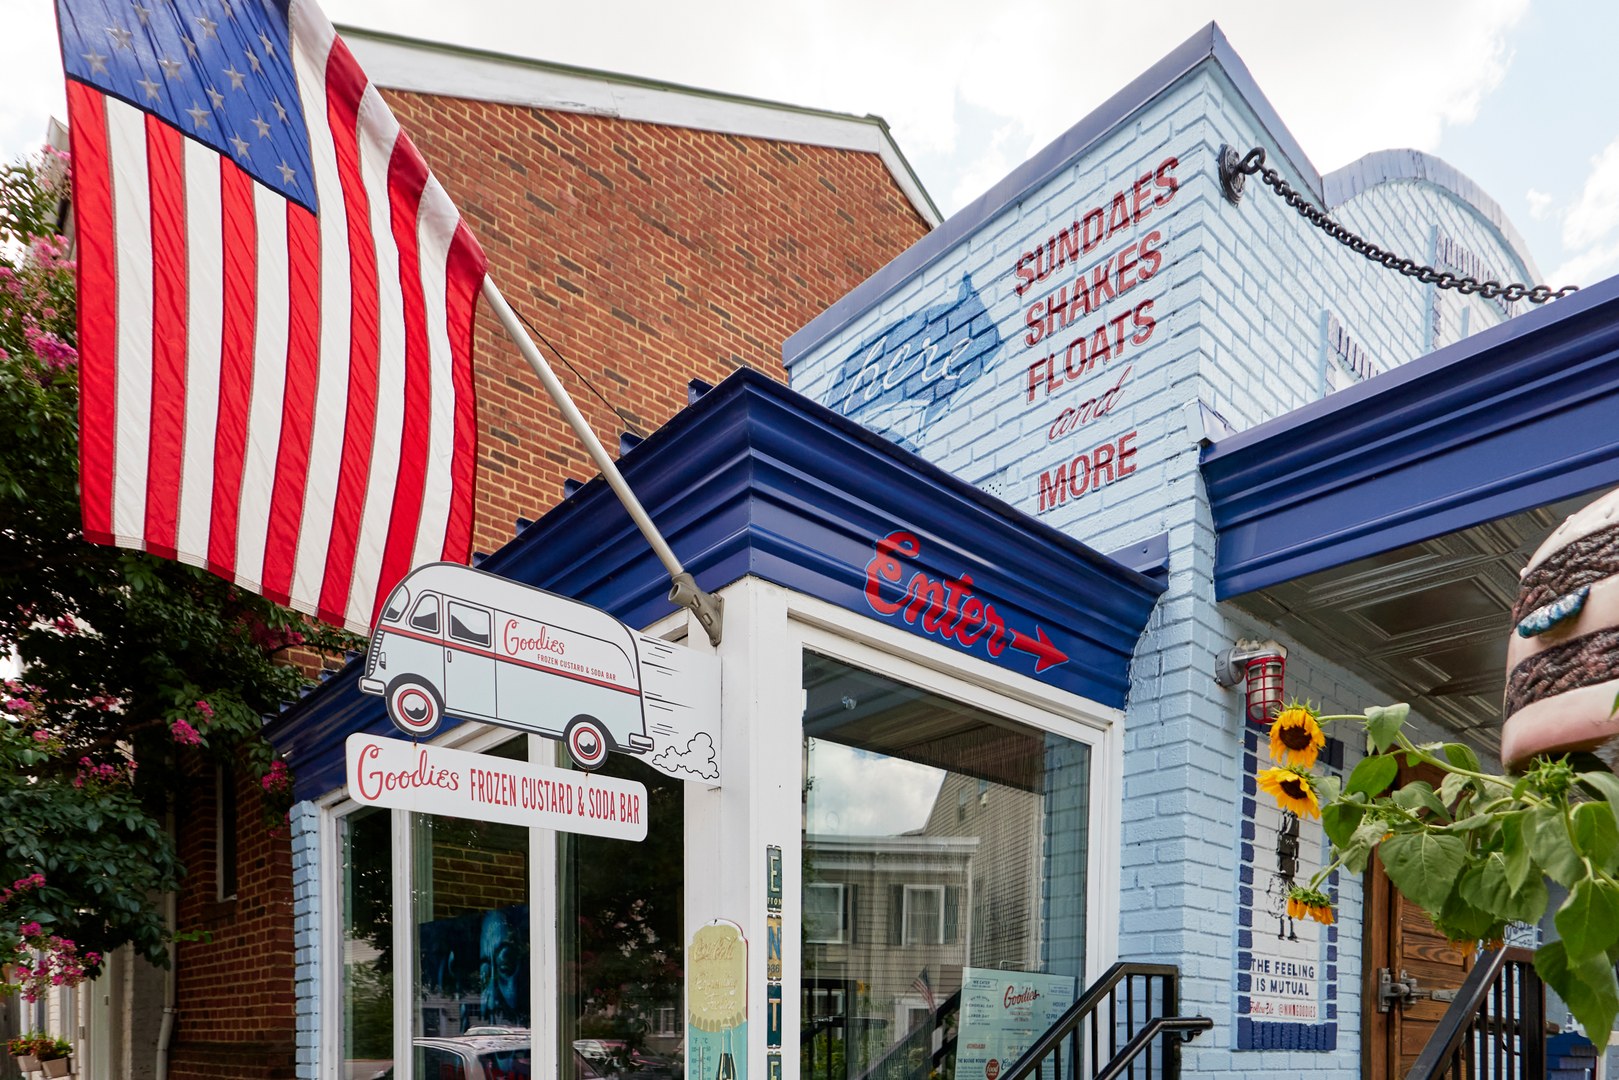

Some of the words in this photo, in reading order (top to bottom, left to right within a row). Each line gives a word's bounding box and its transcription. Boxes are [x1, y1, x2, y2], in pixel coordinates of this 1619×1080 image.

[1014, 156, 1180, 297] SUNDAES
[1024, 230, 1163, 348] SHAKES
[844, 336, 972, 416] here
[1026, 299, 1157, 405] FLOATS
[1049, 364, 1132, 442] and
[1038, 430, 1139, 515] MORE
[864, 530, 1007, 658] Enter
[504, 619, 565, 656] Goodies
[538, 654, 559, 666] FROZEN
[560, 659, 584, 673] CUSTARD
[591, 668, 604, 678] SODA
[606, 671, 616, 681] BAR
[357, 743, 460, 800] Goodies
[471, 768, 517, 807] FROZEN
[521, 776, 573, 815] CUSTARD
[577, 787, 585, 818] &
[588, 787, 616, 821] SODA
[620, 792, 641, 824] BAR
[1004, 985, 1040, 1009] Goodies
[1251, 958, 1270, 974] THE
[1275, 962, 1314, 978] FEELING
[1256, 978, 1266, 991] IS
[1270, 980, 1309, 996] MUTUAL
